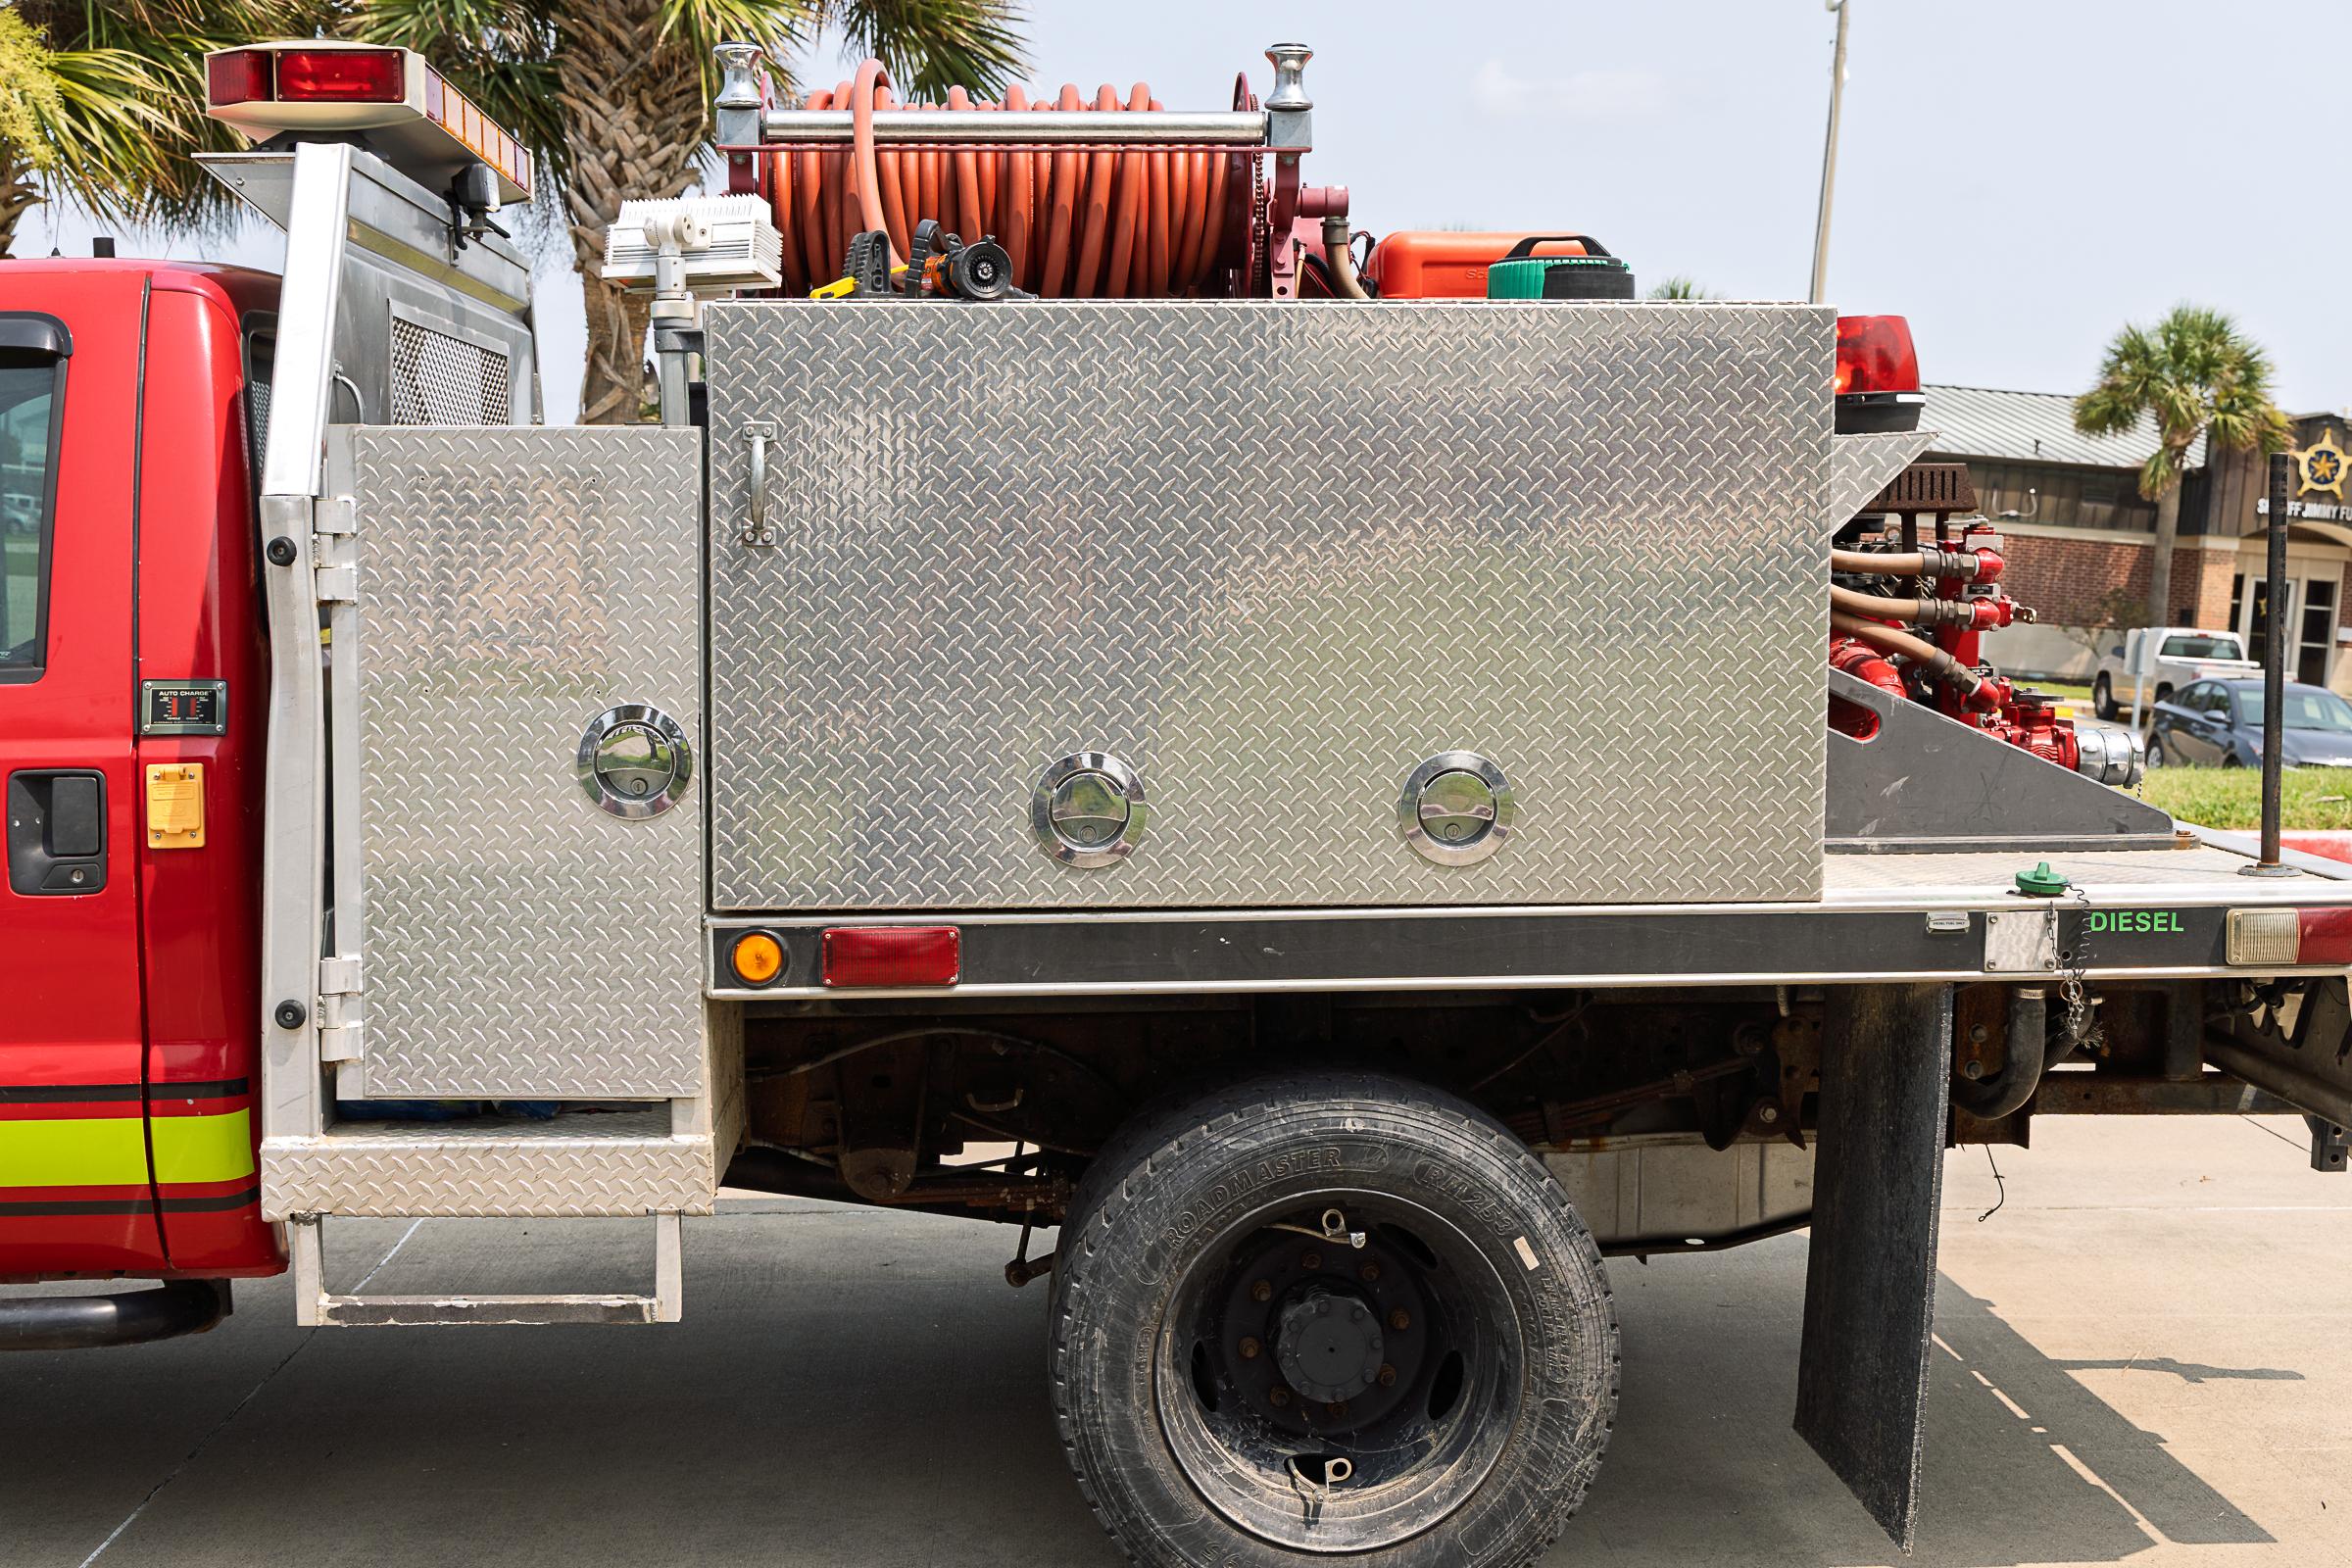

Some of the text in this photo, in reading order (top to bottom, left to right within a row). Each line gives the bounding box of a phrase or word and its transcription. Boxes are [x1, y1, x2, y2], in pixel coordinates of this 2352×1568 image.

[2302, 502, 2339, 519] JIMMY
[2090, 911, 2184, 932] DIESEL
[1162, 1146, 1342, 1250] ROADMASTER
